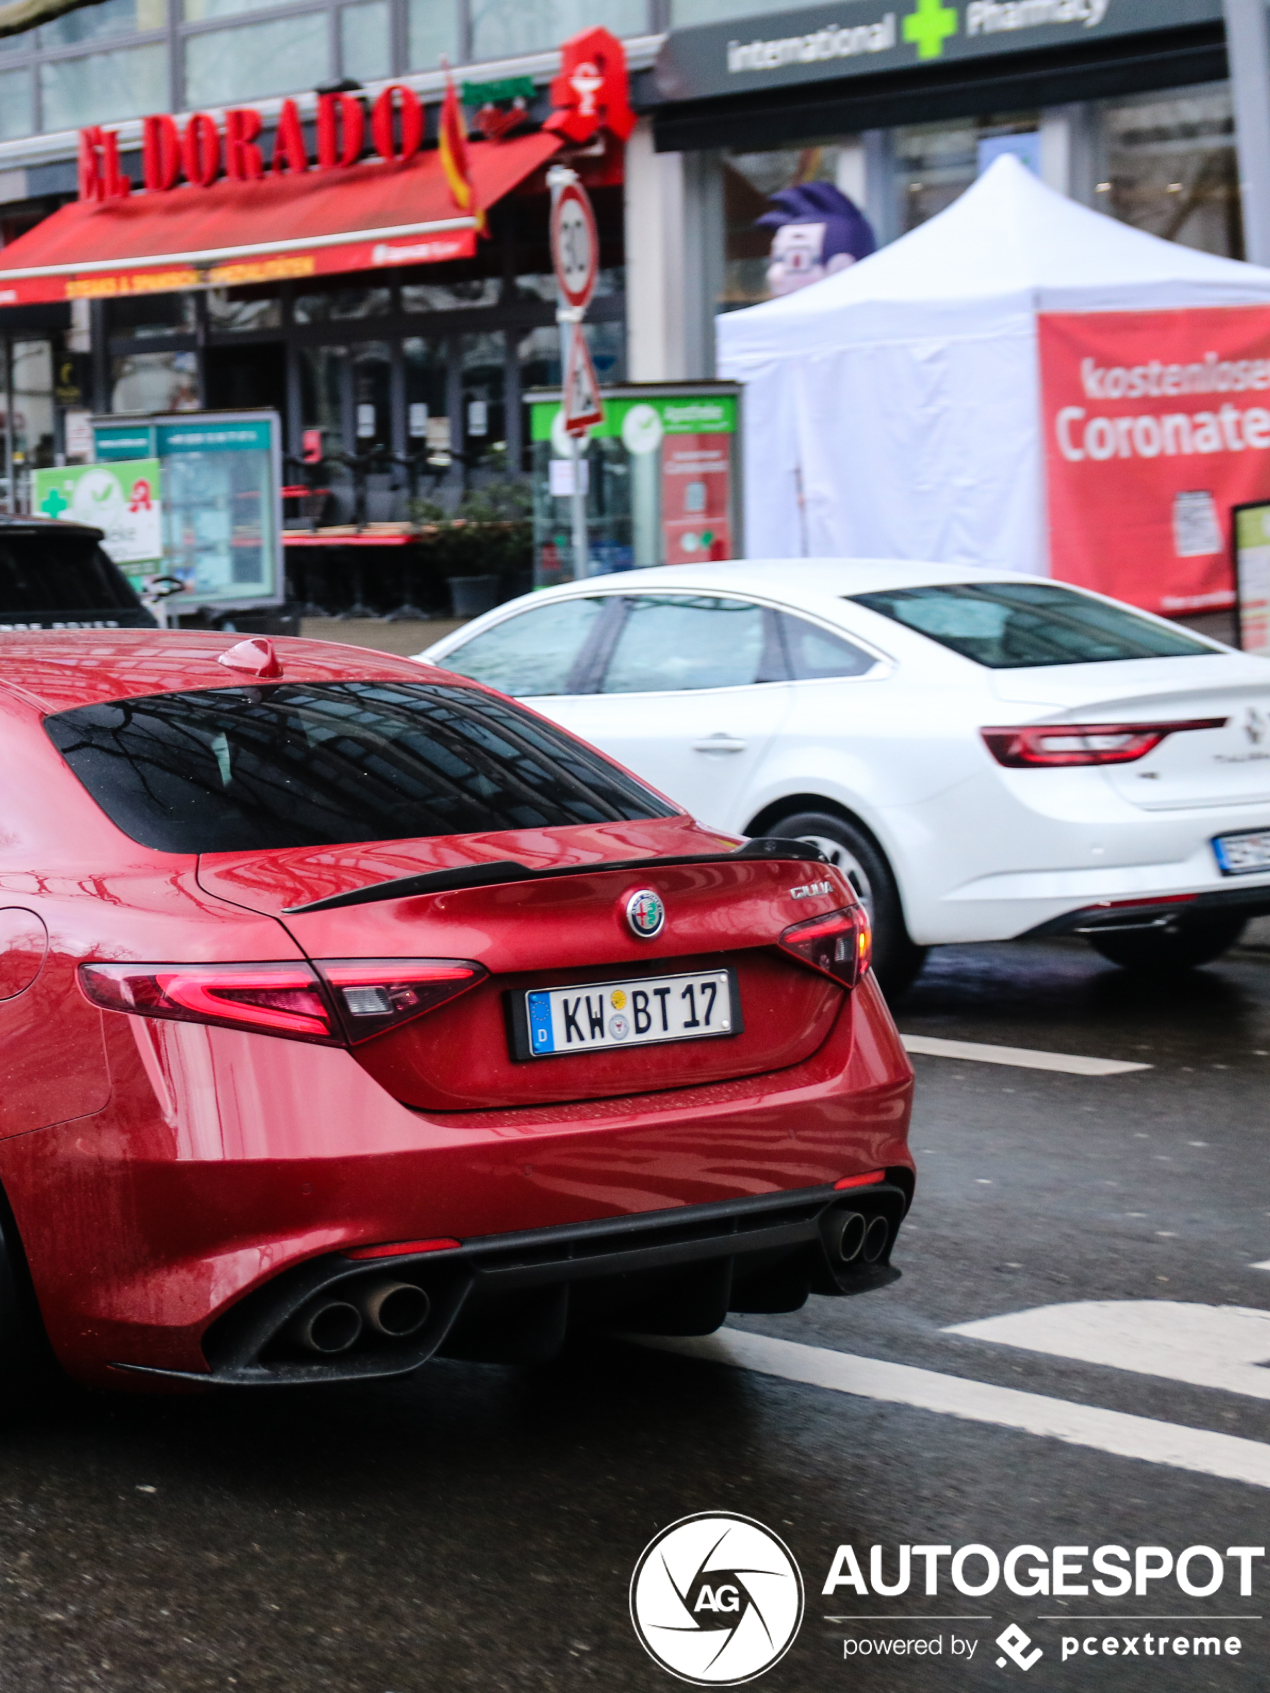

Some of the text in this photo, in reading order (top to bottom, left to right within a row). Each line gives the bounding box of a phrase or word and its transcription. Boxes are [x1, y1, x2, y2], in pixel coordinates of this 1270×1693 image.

[78, 126, 130, 201] EL
[143, 85, 425, 191] DORADO
[561, 218, 587, 273] 30
[537, 1029, 548, 1043] D
[562, 981, 718, 1043] KW BT 17
